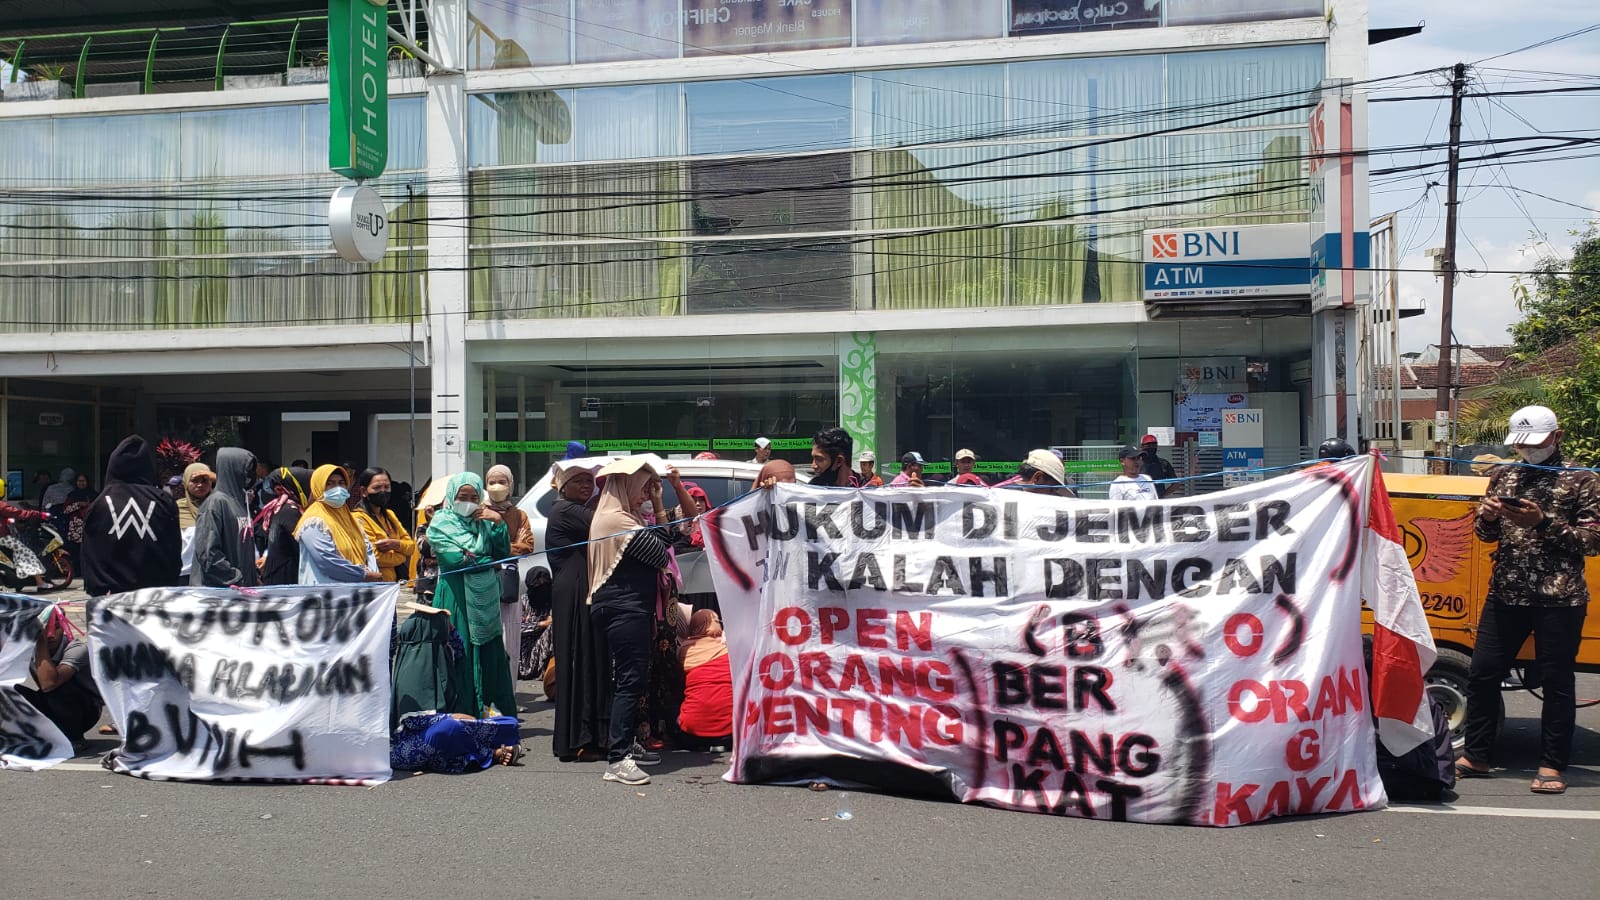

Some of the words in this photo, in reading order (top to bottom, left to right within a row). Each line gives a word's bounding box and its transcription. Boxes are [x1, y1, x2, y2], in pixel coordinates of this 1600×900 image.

[362, 10, 378, 137] HOTEL
[1183, 231, 1240, 257] BNI
[1154, 267, 1204, 286] ATM
[1203, 366, 1235, 380] BNI
[1237, 413, 1260, 424] BNI
[1226, 451, 1247, 460] ATM
[741, 502, 937, 551] HUKUM
[962, 502, 1019, 541] DI
[1037, 500, 1296, 544] JEMBER
[807, 551, 1008, 598] KALAH
[1044, 552, 1297, 601] DENGAN
[774, 606, 934, 652] OPEN
[758, 651, 955, 702] ORANG
[991, 660, 1117, 713] BER
[1226, 665, 1365, 724] ORAN
[744, 695, 964, 749] PENTING
[993, 718, 1161, 778] PANG
[1286, 728, 1321, 772] G
[1011, 762, 1144, 822] KAT
[1215, 768, 1366, 826] KAYA
